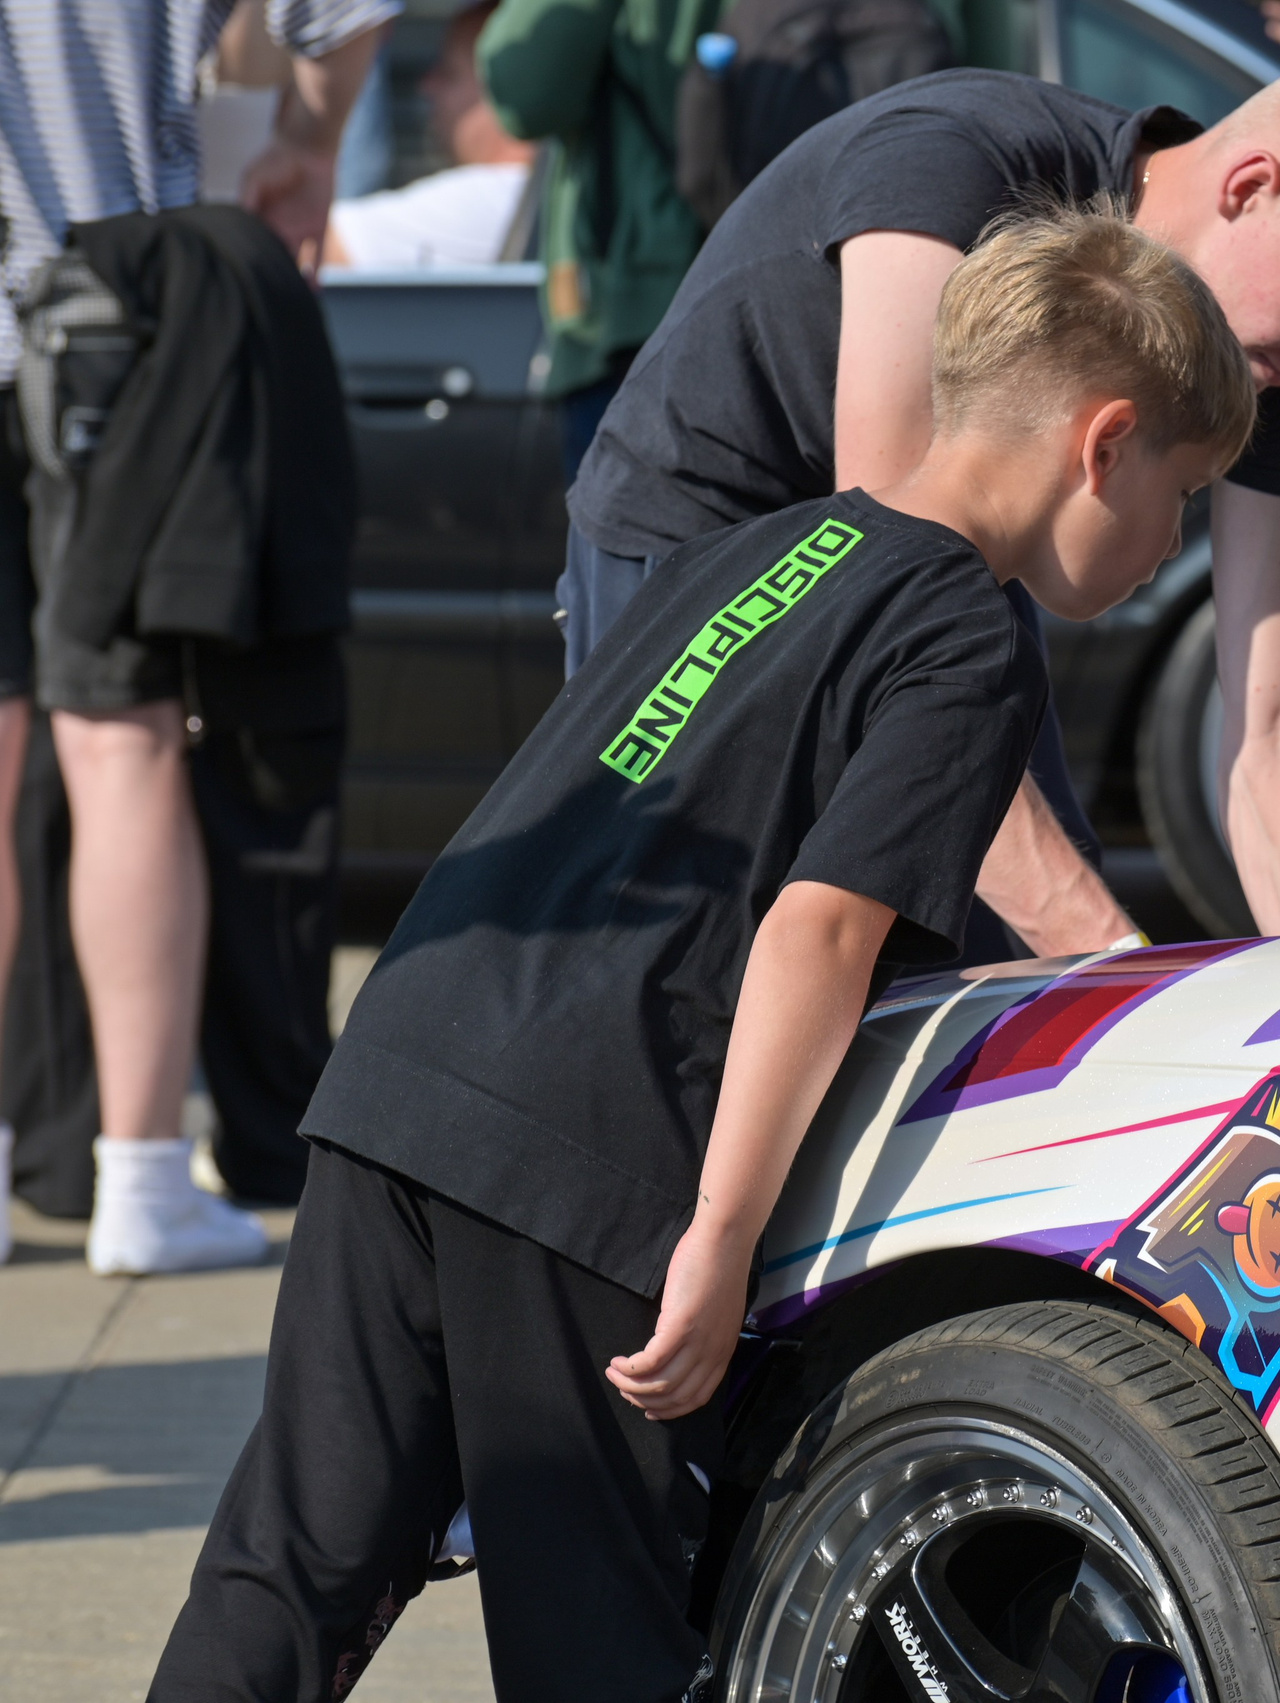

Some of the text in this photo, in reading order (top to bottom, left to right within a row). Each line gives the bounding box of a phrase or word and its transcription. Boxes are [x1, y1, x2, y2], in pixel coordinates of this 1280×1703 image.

[608, 523, 857, 778] DISCIPLINE
[963, 1387, 988, 1397] LOAD
[1115, 1469, 1138, 1493] MADE
[1136, 1493, 1148, 1505] IN
[1144, 1504, 1169, 1537] KOREA
[884, 1601, 929, 1678] WORK
[1202, 1610, 1215, 1640] MAX.
[1213, 1639, 1228, 1672] LOAD
[1224, 1646, 1237, 1679] CANADA
[1233, 1681, 1242, 1698] AND
